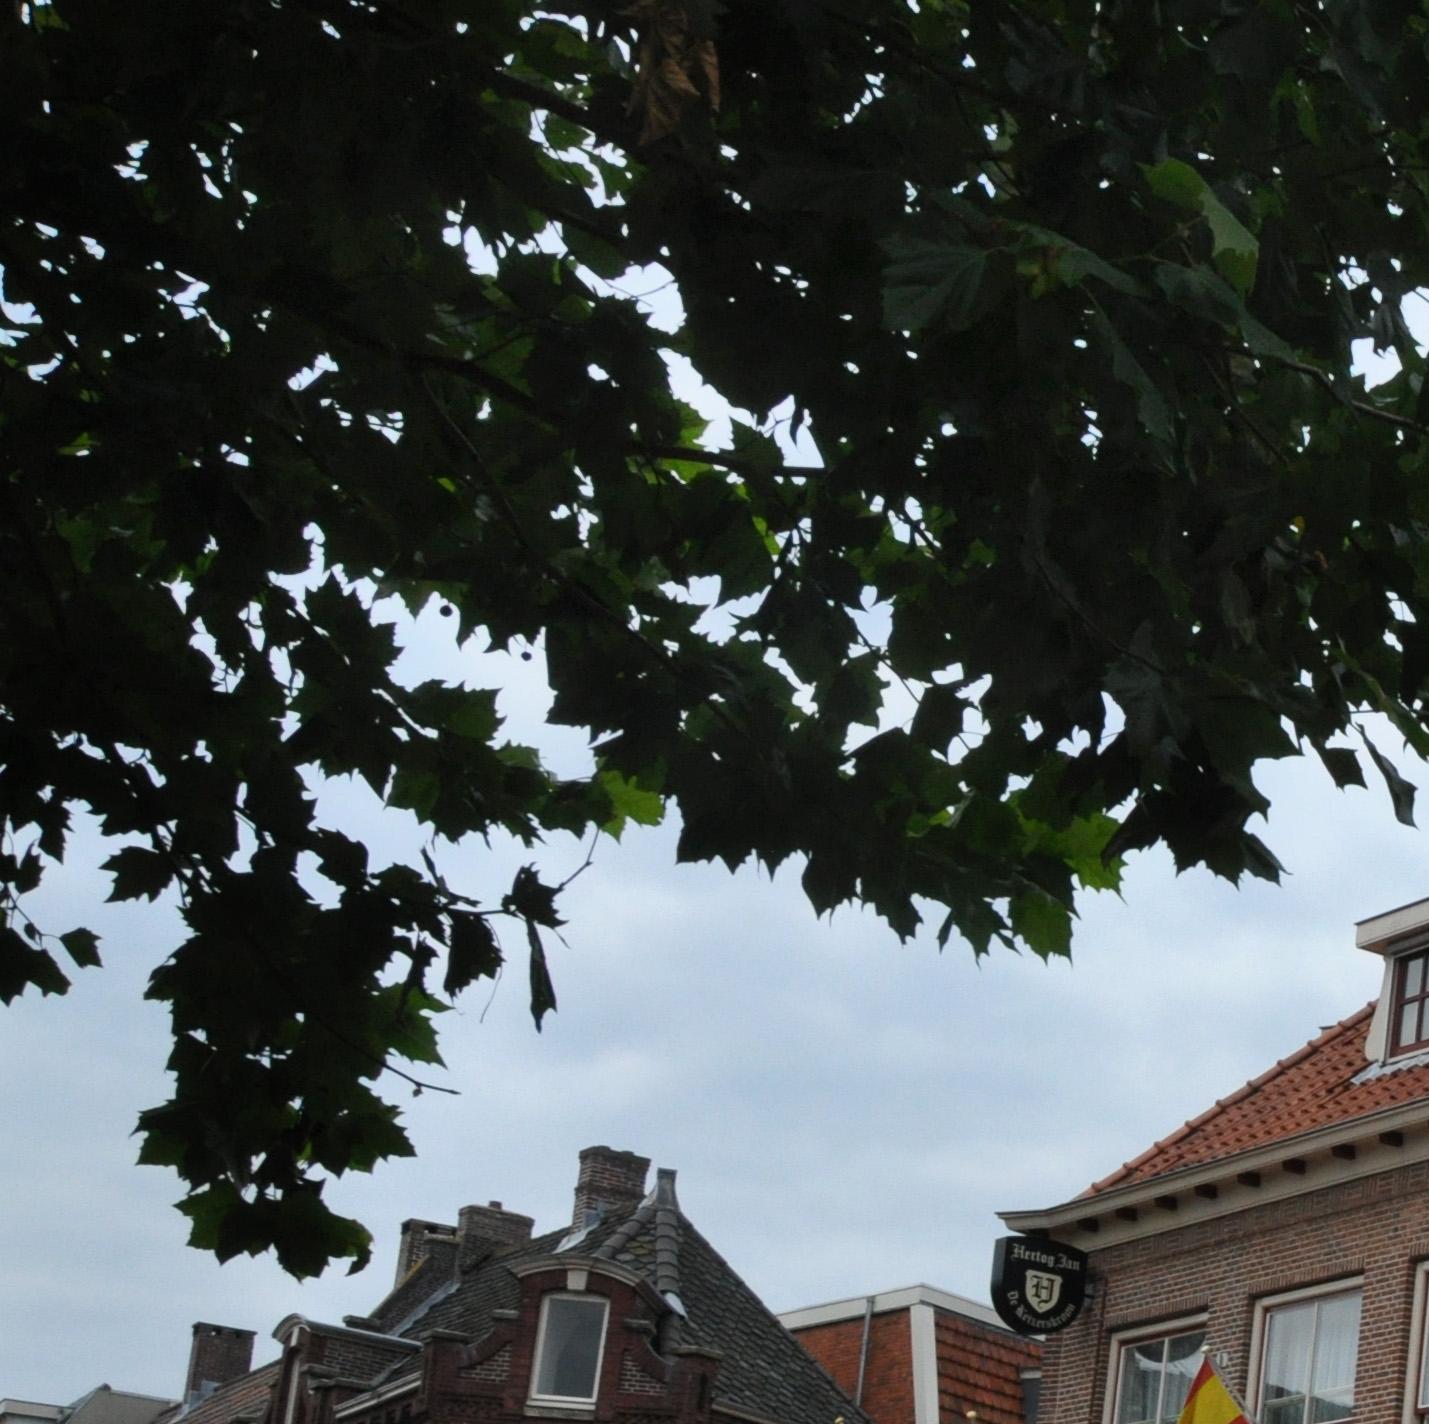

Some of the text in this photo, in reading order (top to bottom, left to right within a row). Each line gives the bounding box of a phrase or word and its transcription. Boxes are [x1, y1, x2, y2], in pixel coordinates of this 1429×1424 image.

[1010, 1243, 1081, 1272] Hertog Jan
[1007, 1290, 1077, 1329] De Keizerskroon
